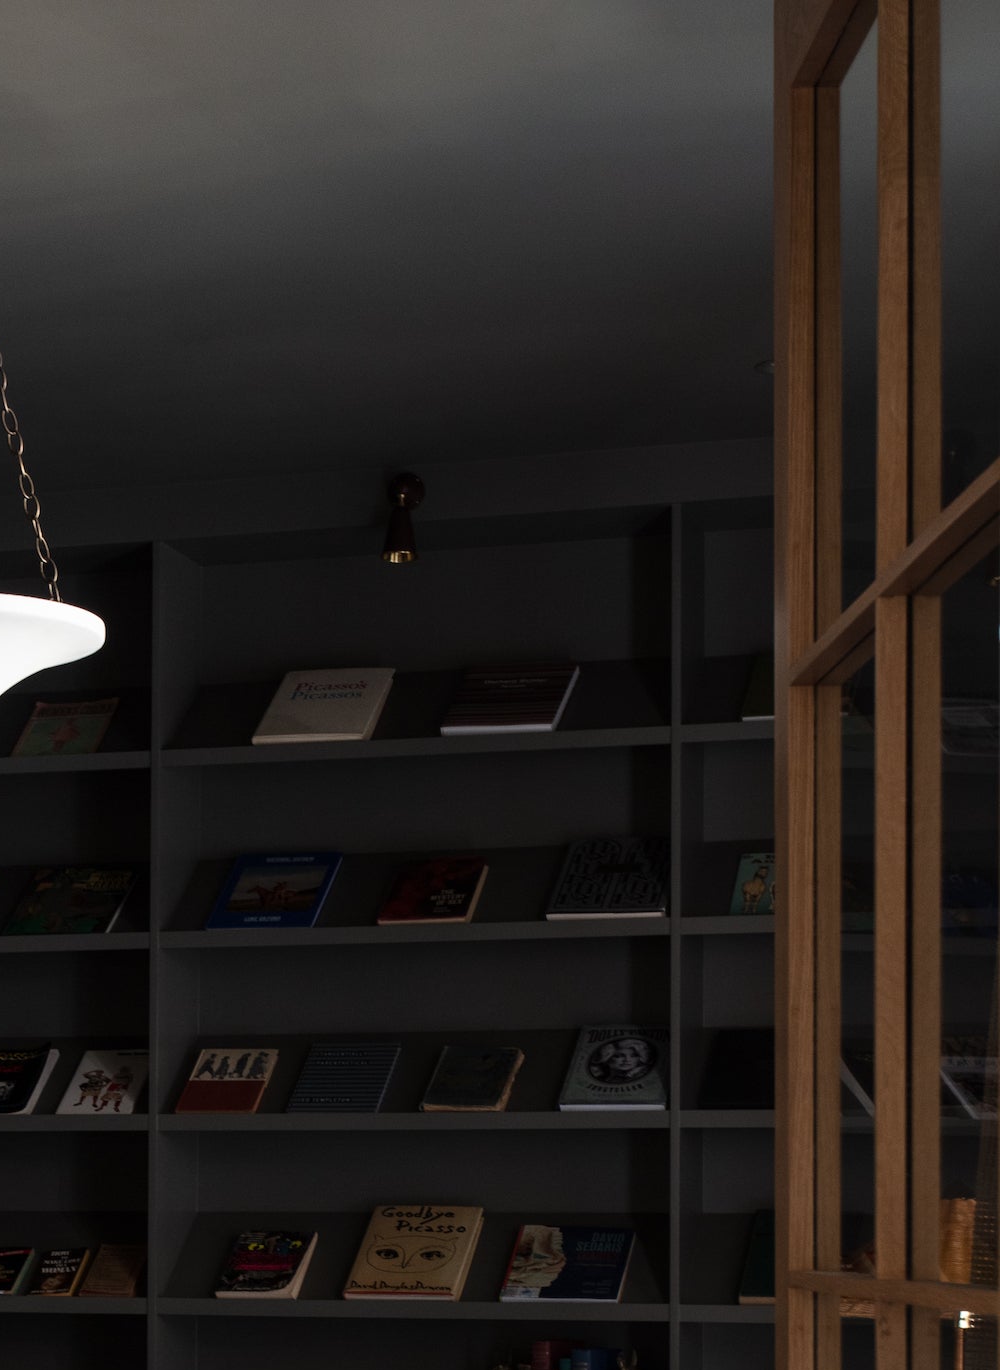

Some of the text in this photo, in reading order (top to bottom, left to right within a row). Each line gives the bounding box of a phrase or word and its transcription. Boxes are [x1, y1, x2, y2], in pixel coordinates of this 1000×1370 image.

[290, 690, 362, 700] Picassos
[382, 1207, 456, 1225] Goodbye
[396, 1220, 467, 1234] Picasso
[591, 1232, 626, 1242] DAVID
[576, 1240, 624, 1252] SEDARIS
